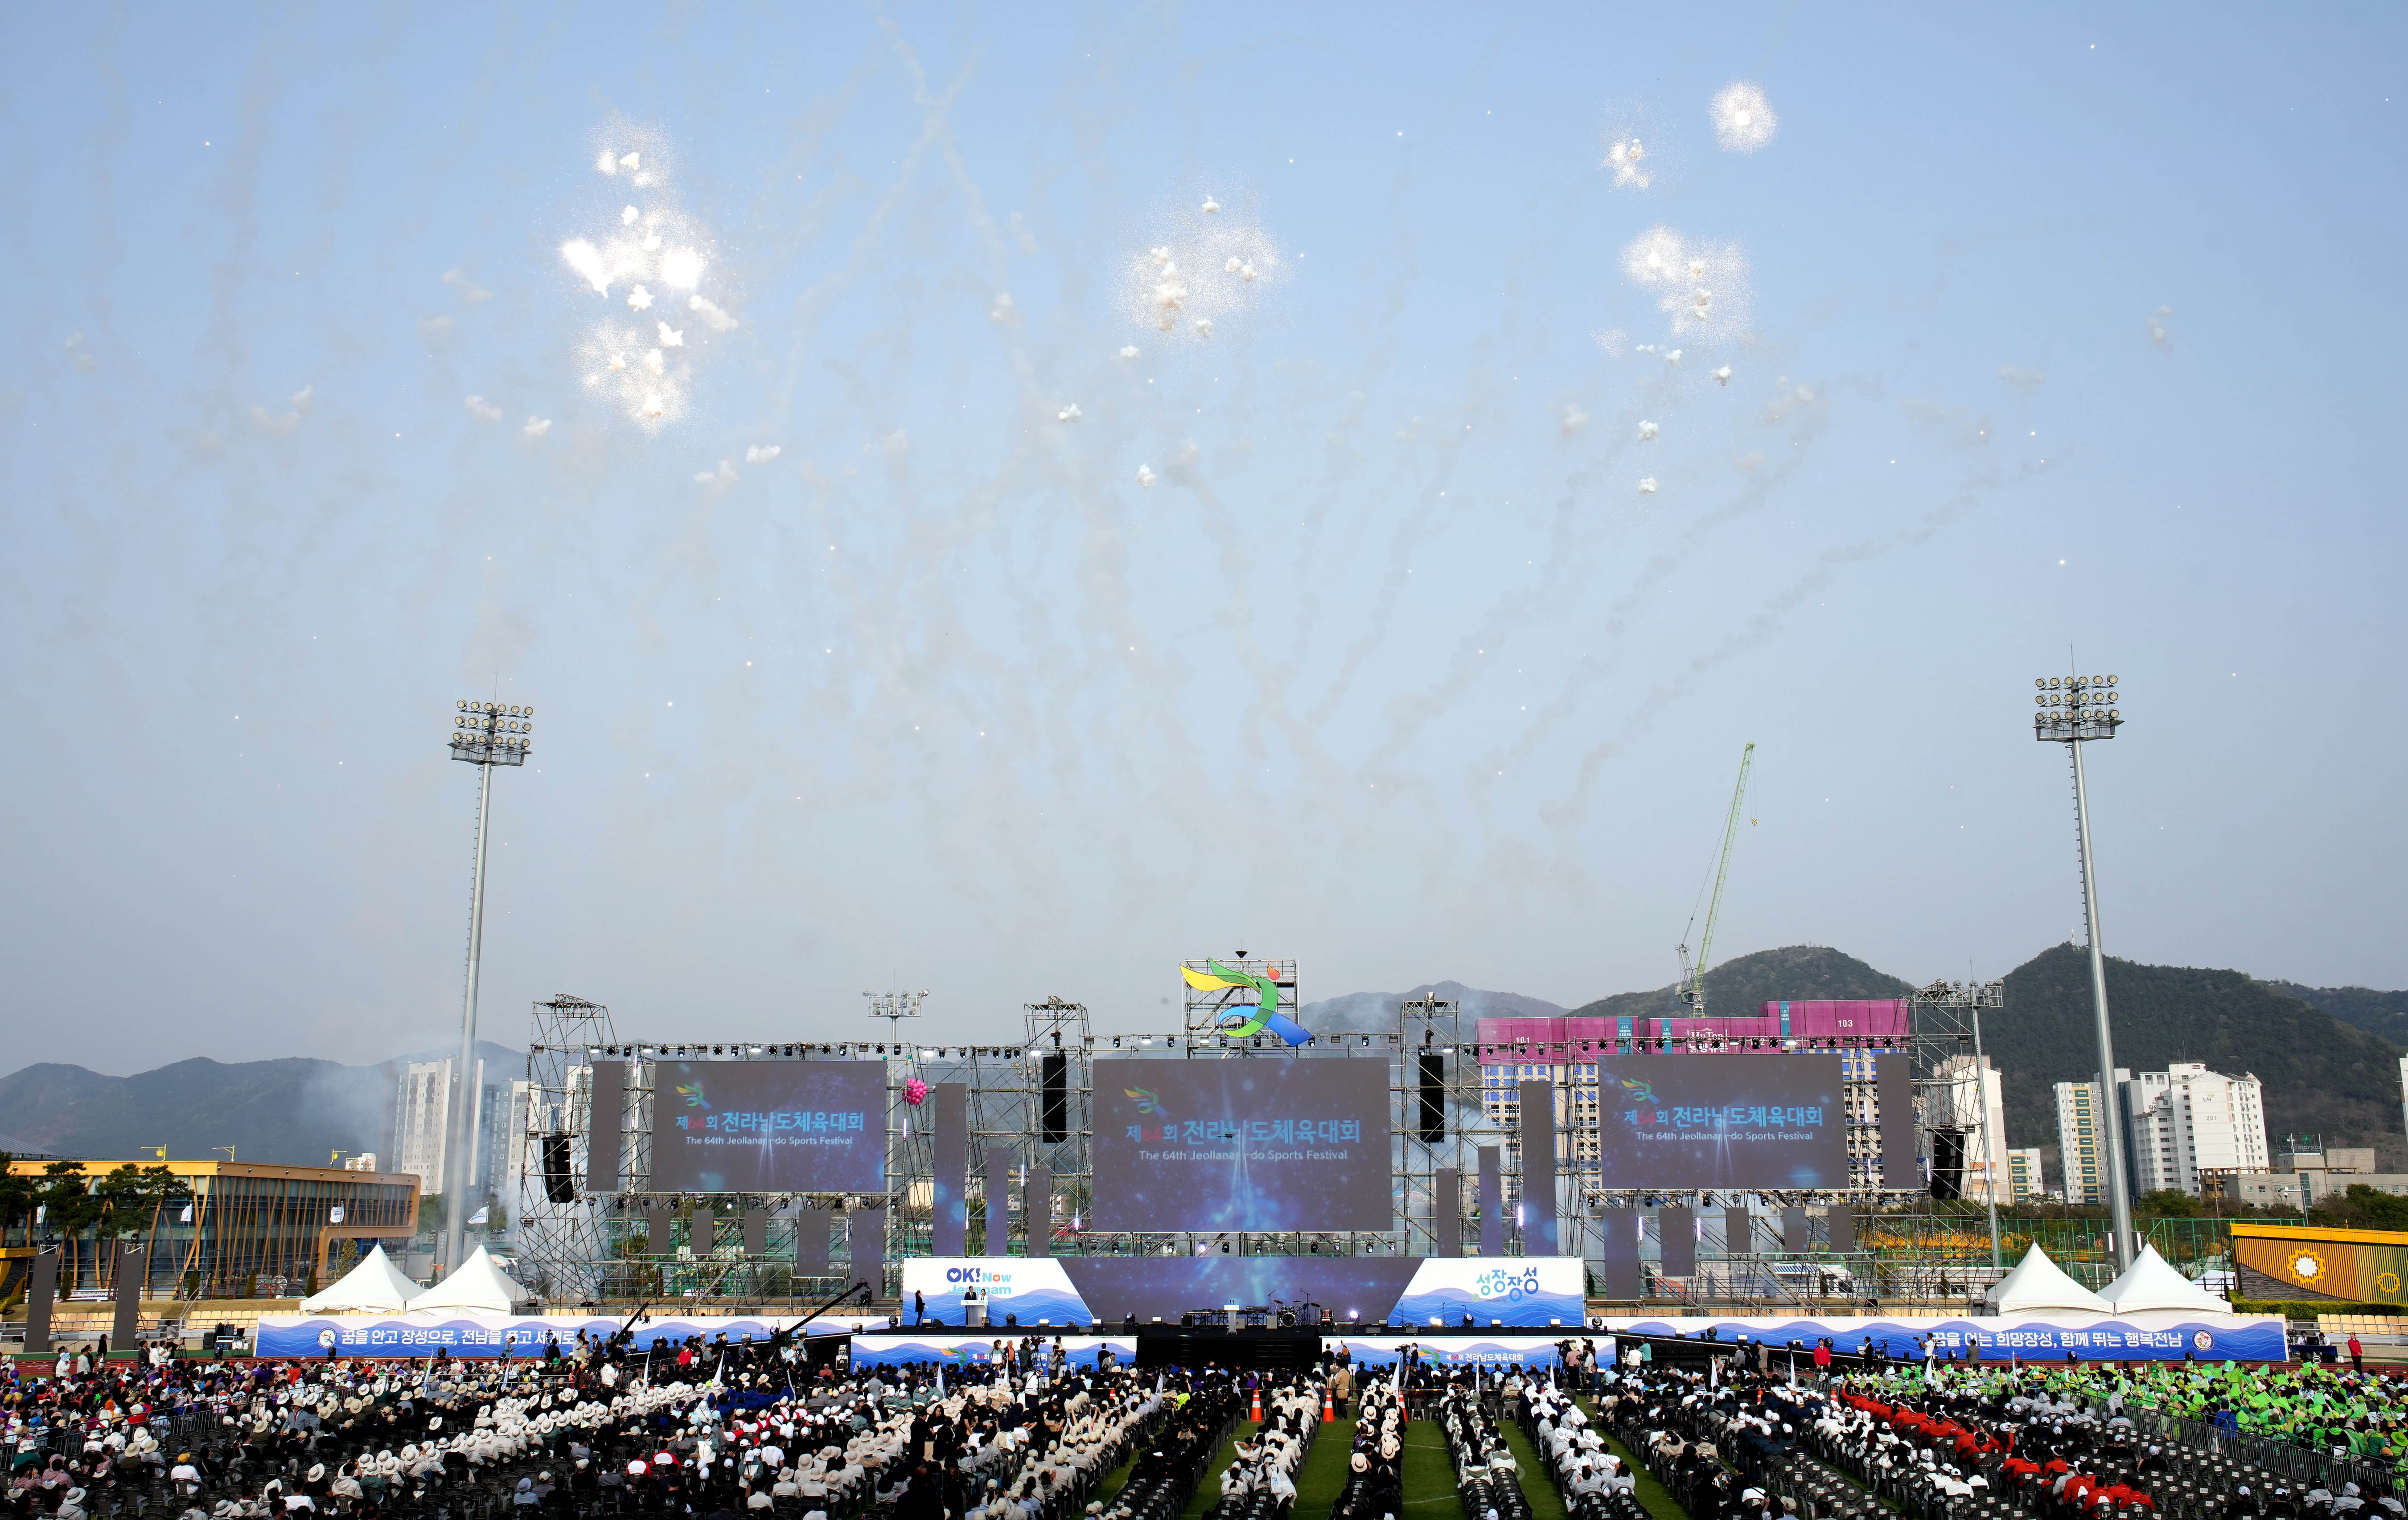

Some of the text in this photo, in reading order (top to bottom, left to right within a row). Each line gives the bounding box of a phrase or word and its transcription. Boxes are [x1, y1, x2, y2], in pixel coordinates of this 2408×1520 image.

[1751, 1038, 1765, 1046] 12
[676, 1111, 863, 1132] 제64회 전라남도체육대회
[1623, 1106, 1823, 1127] 제64회 전라남도체육대회
[1126, 1119, 1360, 1145] 제64회 전라남도체육대회
[1636, 1131, 1654, 1140] The
[1656, 1131, 1677, 1140] 64th
[1746, 1131, 1775, 1142] Sports
[1778, 1131, 1812, 1140] Festival
[686, 1136, 702, 1145] The
[704, 1136, 724, 1145] 64th
[789, 1137, 817, 1147] Sports
[820, 1136, 852, 1145] Festival
[1139, 1150, 1159, 1160] The
[1163, 1150, 1186, 1160] 64th
[1268, 1150, 1303, 1162] Sports
[1307, 1149, 1348, 1159] Festival
[946, 1267, 1012, 1283] OK! Now
[342, 1330, 368, 1344] 꿈을
[372, 1330, 398, 1344] 안고
[402, 1330, 458, 1346] 장성으로,
[462, 1330, 502, 1344] 전남을
[505, 1330, 532, 1344] 품고
[535, 1330, 575, 1344] 세계로
[1932, 1332, 2182, 1348] 꿈을 여는 희망장성, 함께 뛰는 행복전남
[1465, 1353, 1524, 1362] 전라남도체육대회
